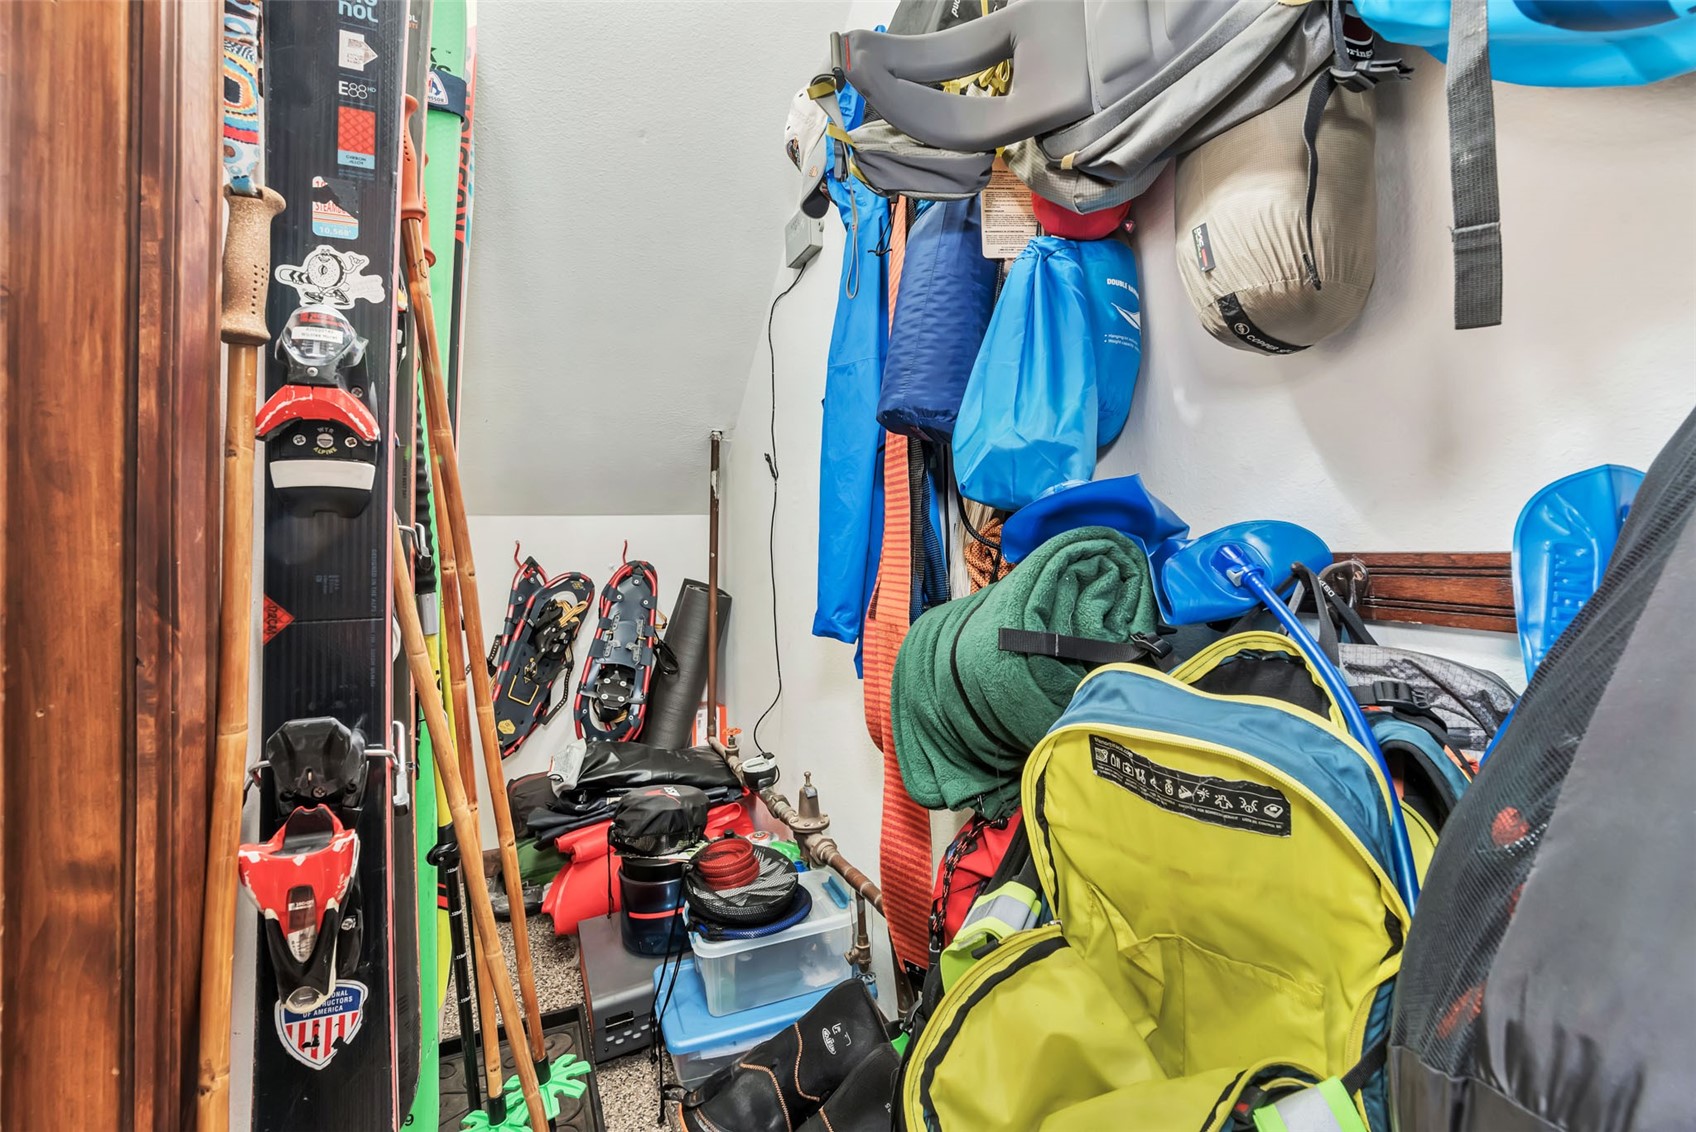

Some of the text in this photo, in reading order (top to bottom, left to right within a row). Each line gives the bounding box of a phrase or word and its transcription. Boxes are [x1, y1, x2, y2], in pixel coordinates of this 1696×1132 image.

[1106, 277, 1128, 290] DOUBLE
[313, 446, 337, 455] ALPINE
[313, 1005, 343, 1016] AMERICA
